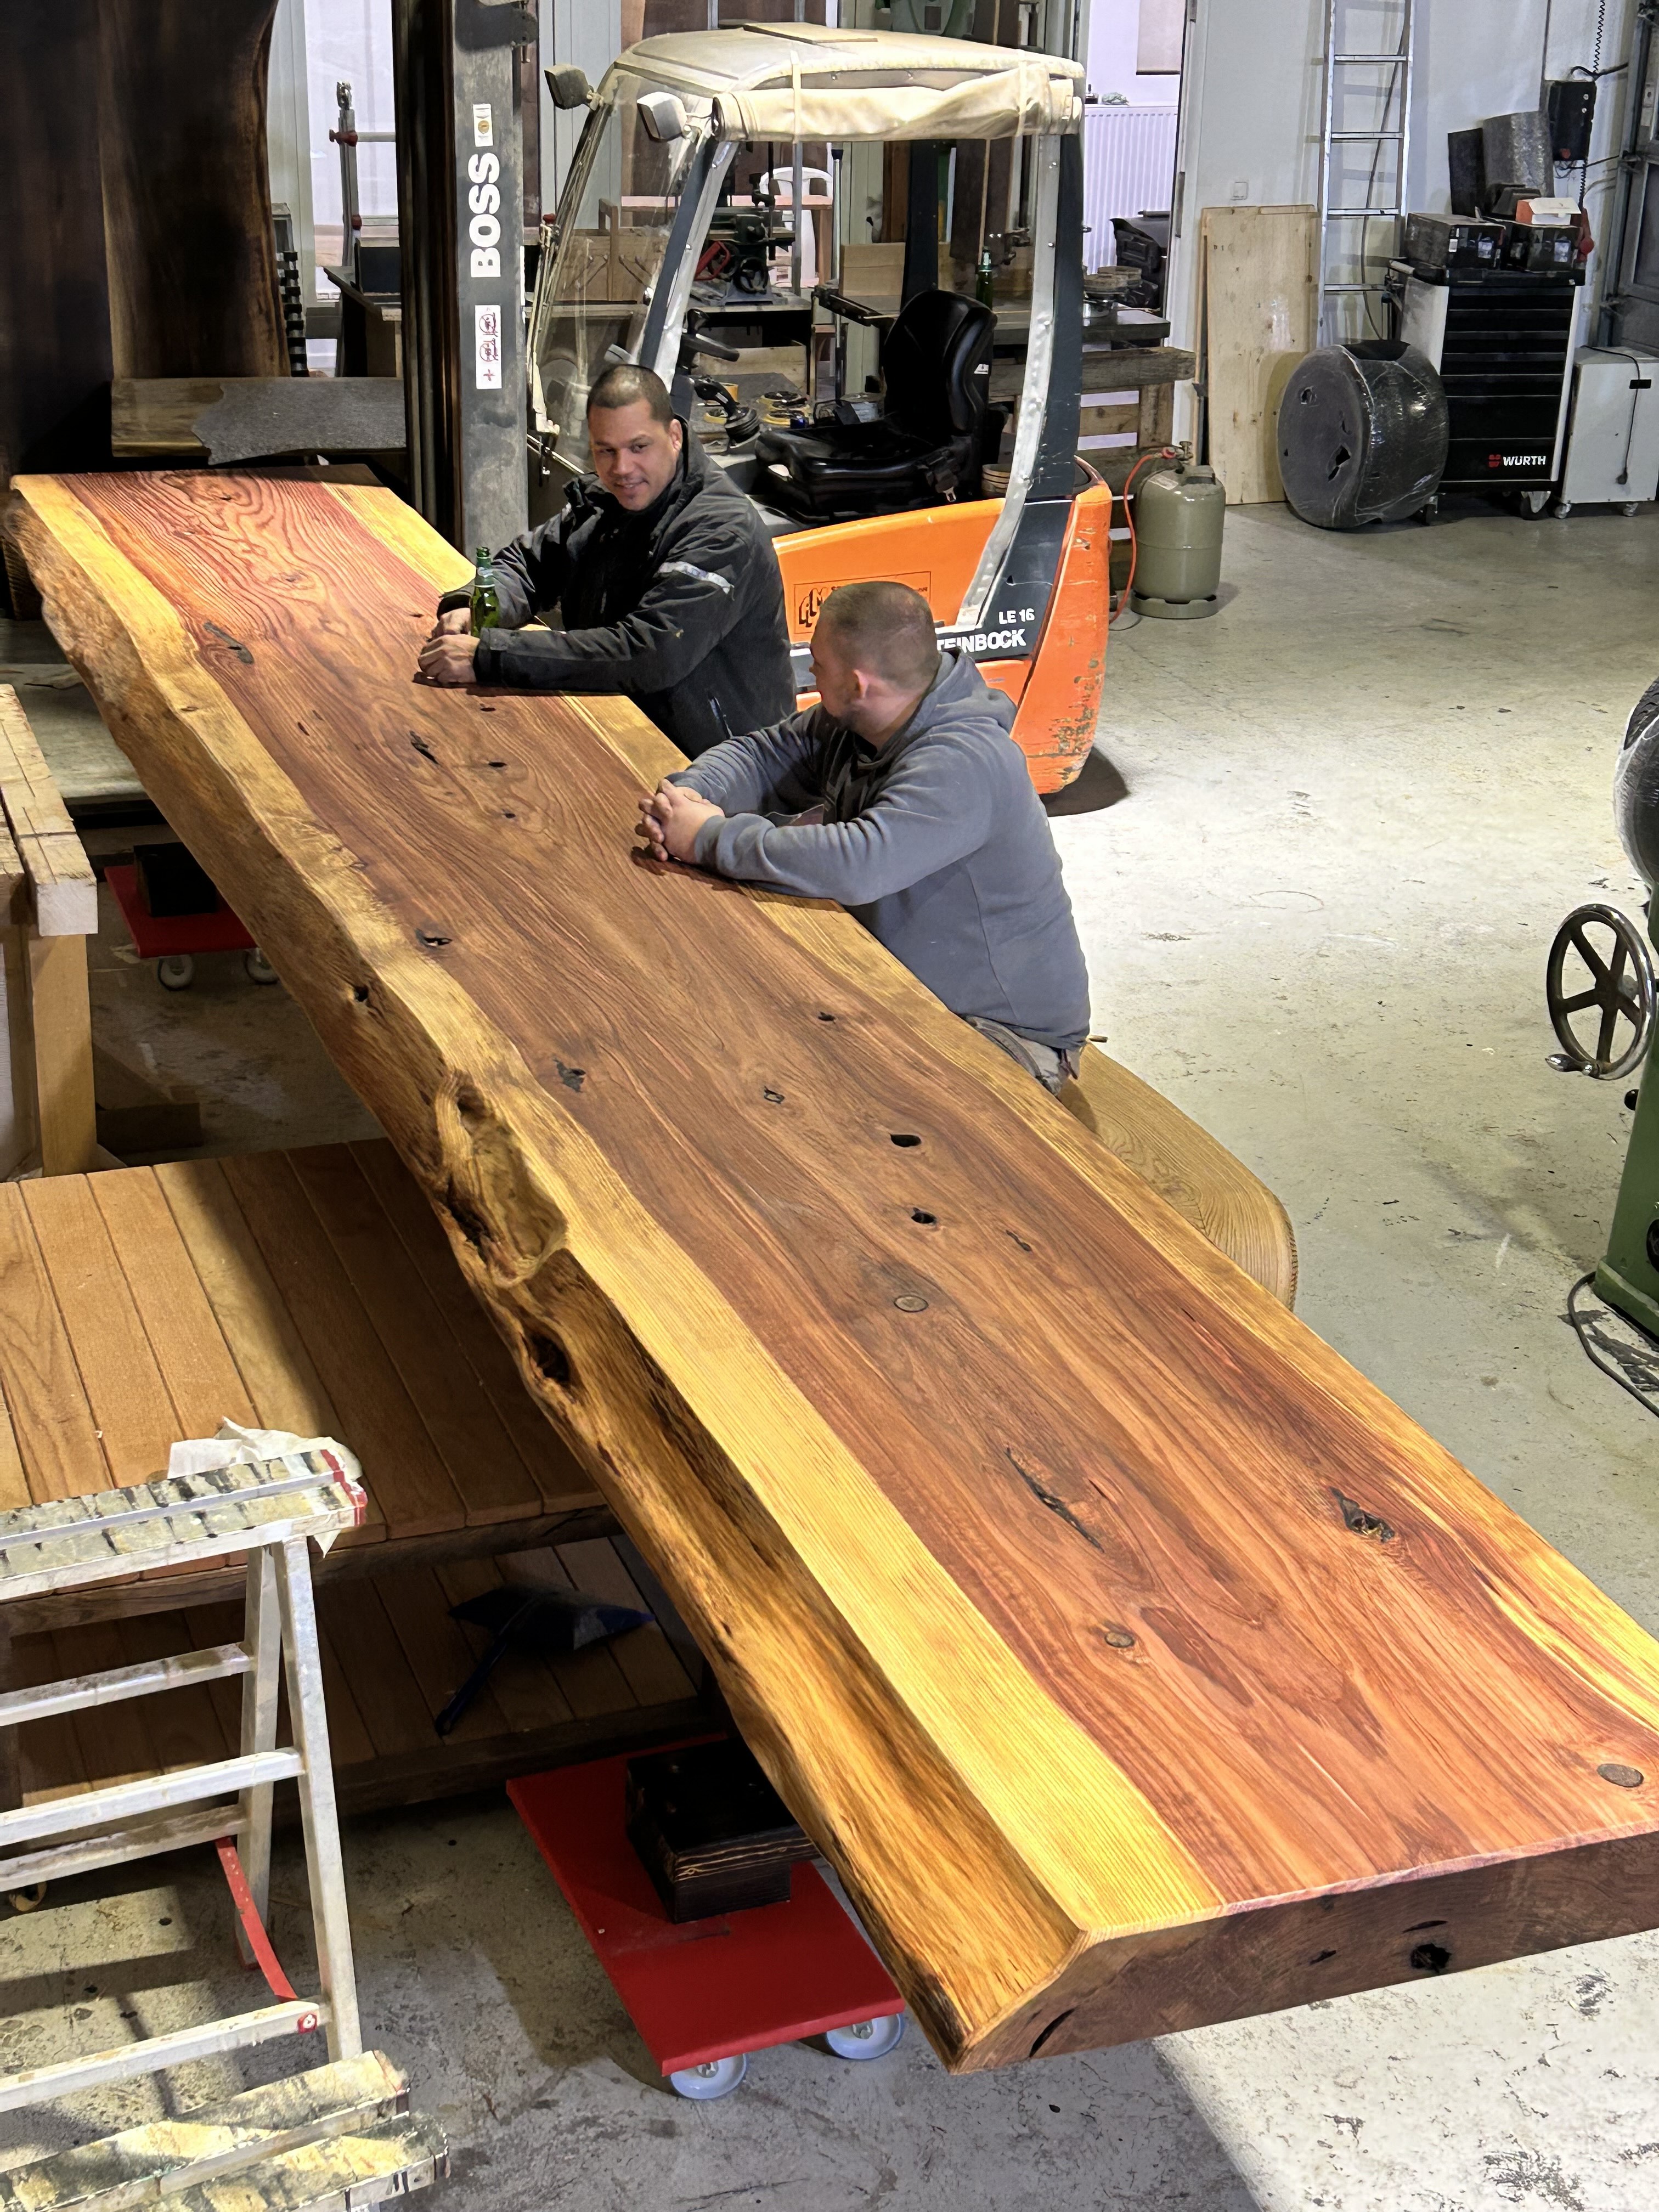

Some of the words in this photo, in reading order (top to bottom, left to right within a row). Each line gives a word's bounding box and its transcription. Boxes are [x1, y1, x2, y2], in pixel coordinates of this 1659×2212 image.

[468, 153, 501, 277] BOSS
[998, 611, 1016, 624] LE
[1019, 608, 1035, 622] 16
[936, 629, 1026, 653] TEINBOCK
